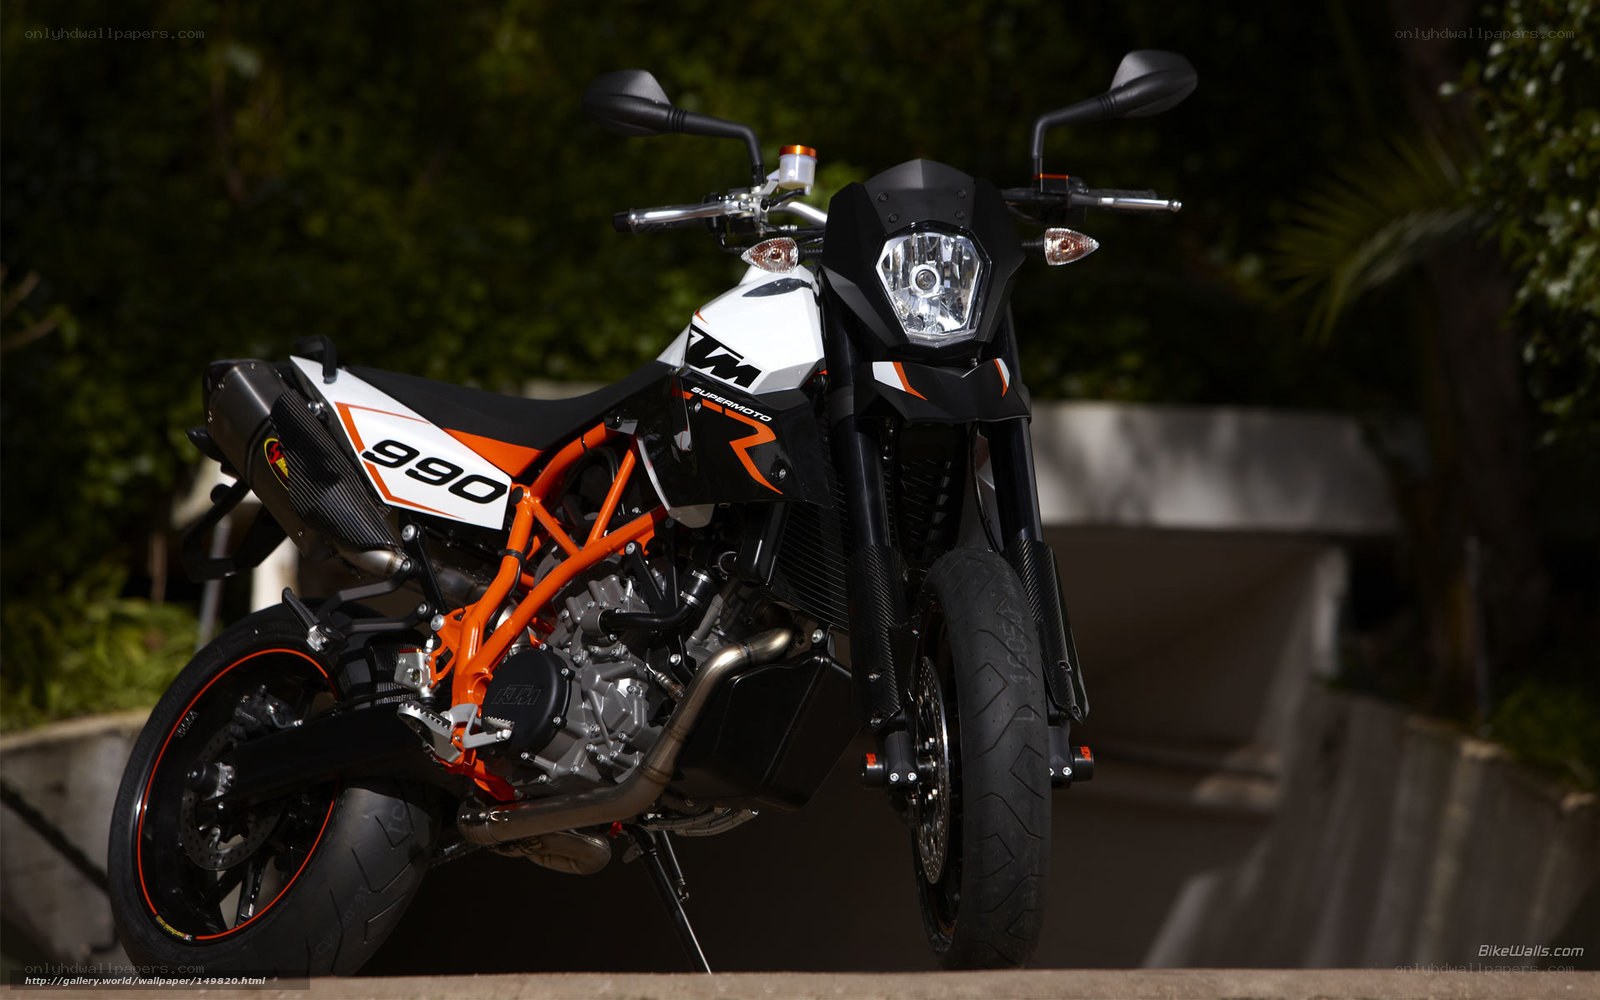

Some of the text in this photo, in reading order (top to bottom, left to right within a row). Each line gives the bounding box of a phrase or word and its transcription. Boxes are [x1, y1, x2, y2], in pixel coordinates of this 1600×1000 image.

[690, 386, 773, 422] SUPERMOTO
[361, 439, 508, 504] 990
[490, 684, 542, 705] KTM
